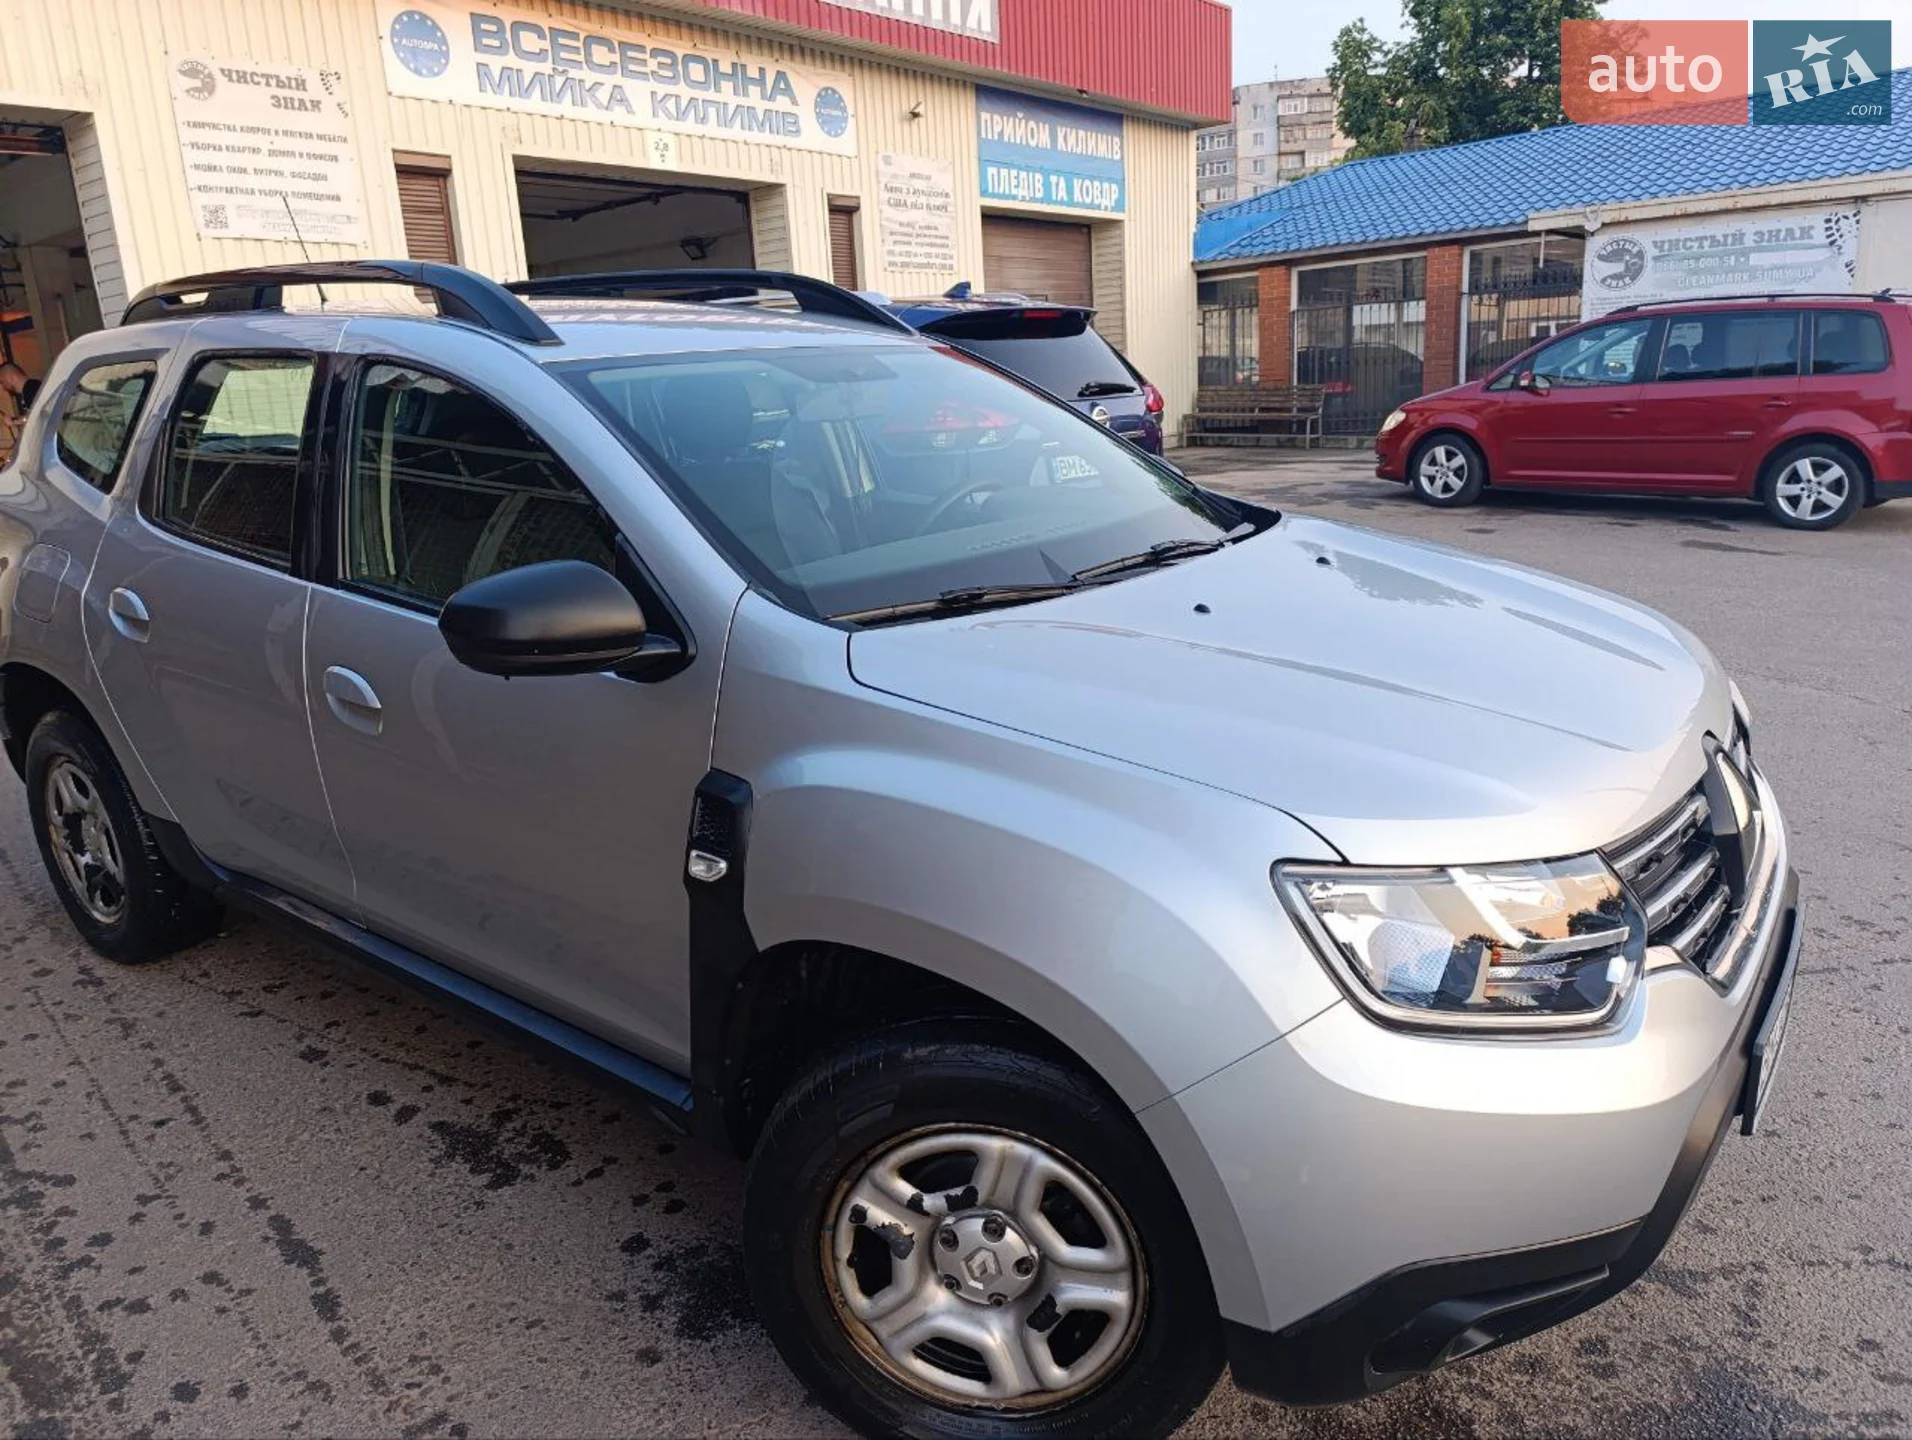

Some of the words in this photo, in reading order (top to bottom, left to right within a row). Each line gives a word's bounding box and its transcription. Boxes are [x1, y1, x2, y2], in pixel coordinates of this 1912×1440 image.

[469, 12, 800, 106] ВСЕСЕЗОННА
[218, 66, 309, 92] ЧИСТЫЙ
[270, 94, 323, 112] ЗНАК
[476, 62, 635, 115] МИЙКА
[650, 90, 802, 138] КИЛИМІВ
[190, 142, 223, 154] УБОРКА
[980, 111, 1051, 149] ПРИЙОМ
[1057, 125, 1121, 160] КИЛИМІВ
[986, 166, 1044, 201] ПЛЕДІВ
[1049, 174, 1068, 202] ТА
[1073, 178, 1119, 211] КОВДР
[1652, 228, 1747, 254] ЧИСТЫЙ
[1752, 224, 1816, 244] ЗНАК
